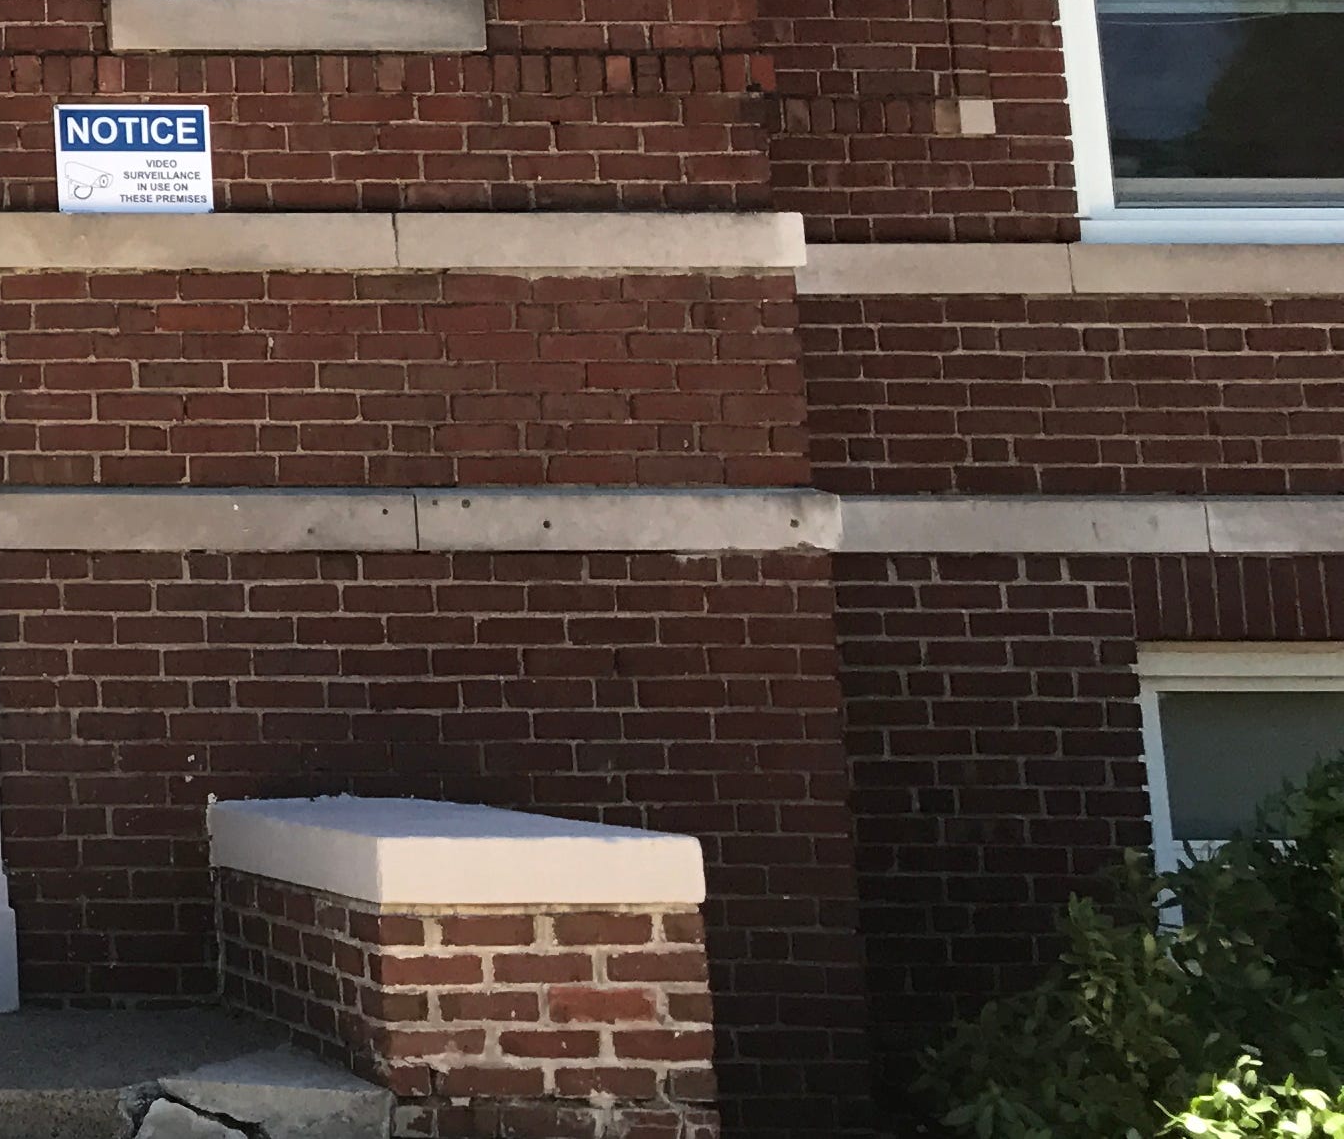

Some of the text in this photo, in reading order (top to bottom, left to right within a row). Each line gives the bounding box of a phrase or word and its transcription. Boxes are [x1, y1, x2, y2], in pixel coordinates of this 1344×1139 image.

[66, 116, 199, 145] NOTICE
[145, 159, 178, 169] VIDEO
[123, 171, 201, 180] SURVEILLANCE
[137, 182, 189, 192] IN USE ON
[120, 194, 208, 204] THESE PREMISES
